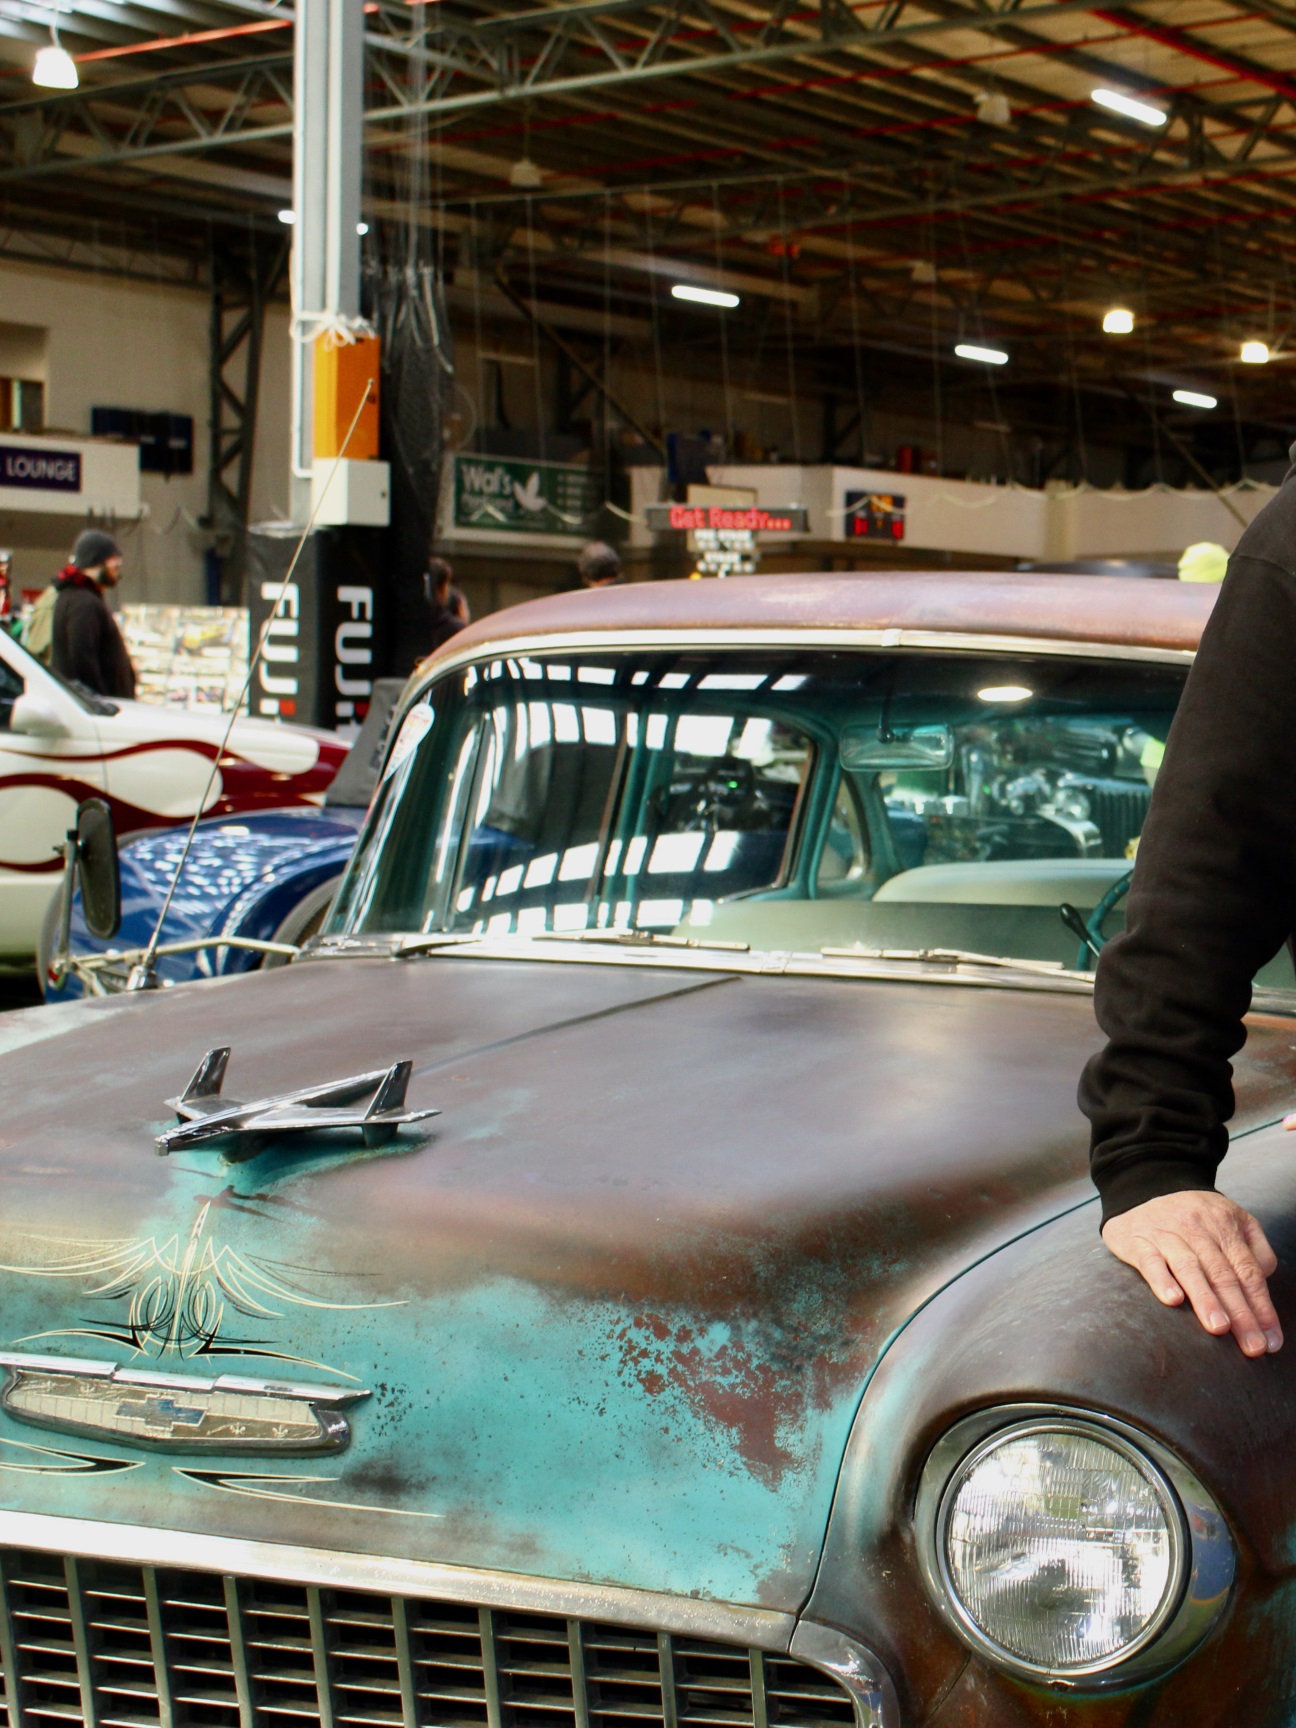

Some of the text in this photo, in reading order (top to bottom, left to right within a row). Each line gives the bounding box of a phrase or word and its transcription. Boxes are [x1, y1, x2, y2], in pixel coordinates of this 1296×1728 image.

[6, 455, 78, 482] LOUNGE
[461, 463, 513, 495] Wal's
[669, 505, 706, 529] Get
